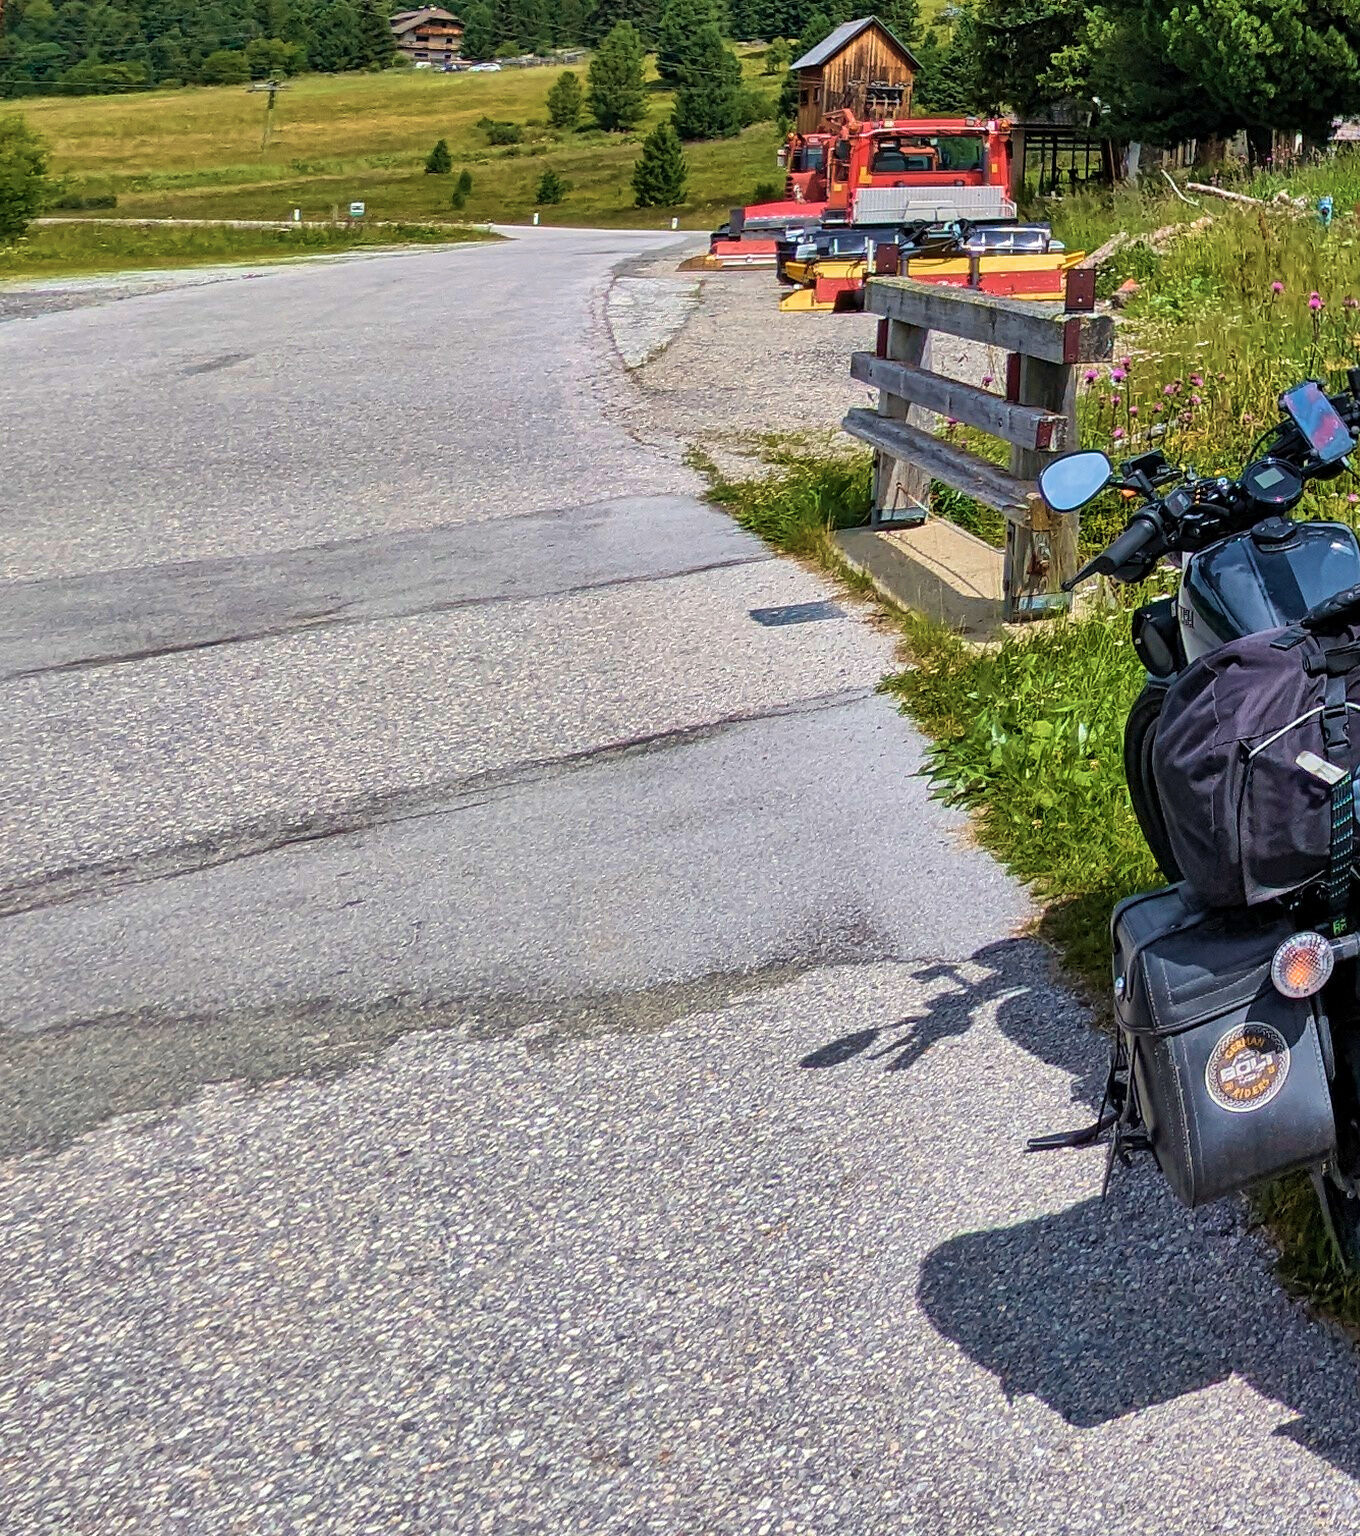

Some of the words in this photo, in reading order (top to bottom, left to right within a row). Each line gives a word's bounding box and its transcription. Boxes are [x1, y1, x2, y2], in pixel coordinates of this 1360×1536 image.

[1224, 1036, 1265, 1060] GERMAN
[1220, 1053, 1273, 1082] BOLT
[1232, 1078, 1270, 1099] RIDERS
